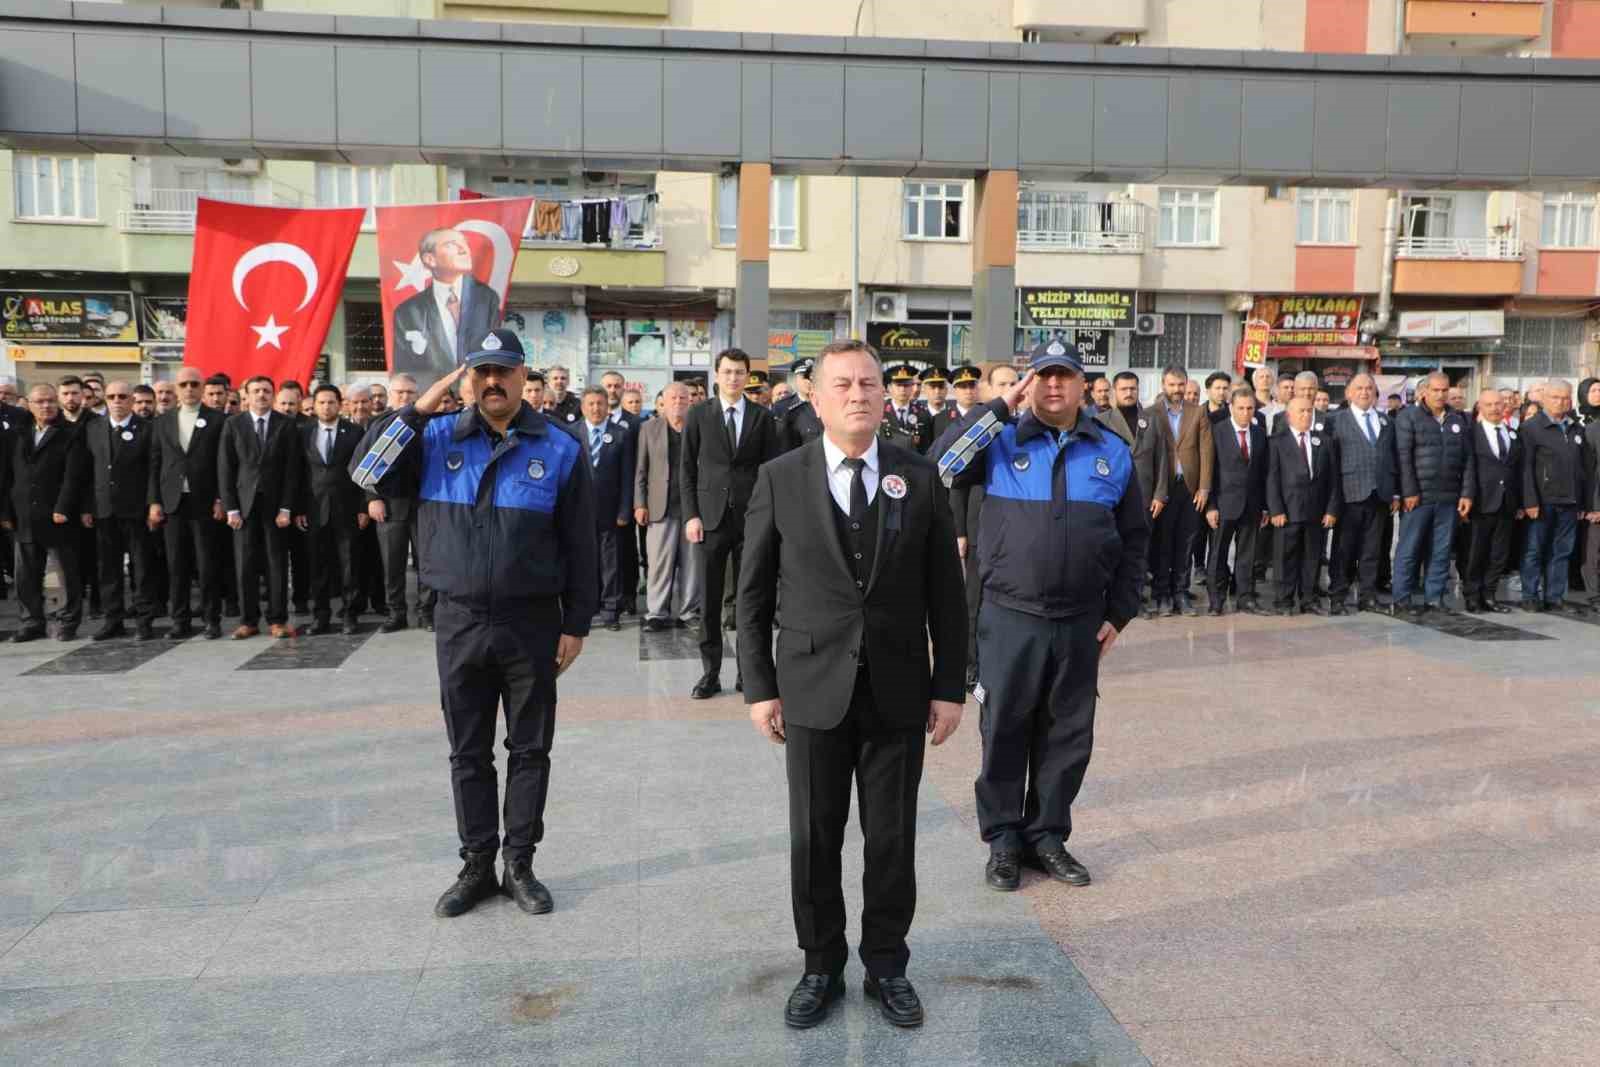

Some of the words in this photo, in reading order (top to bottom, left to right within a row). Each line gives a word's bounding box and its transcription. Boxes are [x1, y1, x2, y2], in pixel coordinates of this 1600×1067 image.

[1030, 307, 1127, 319] TELEFONCUNUZ
[1282, 299, 1357, 312] MEVLANA
[1284, 312, 1337, 328] DÖNER
[1341, 316, 1351, 328] 2
[1078, 337, 1096, 352] gel
[1246, 344, 1261, 362] 35
